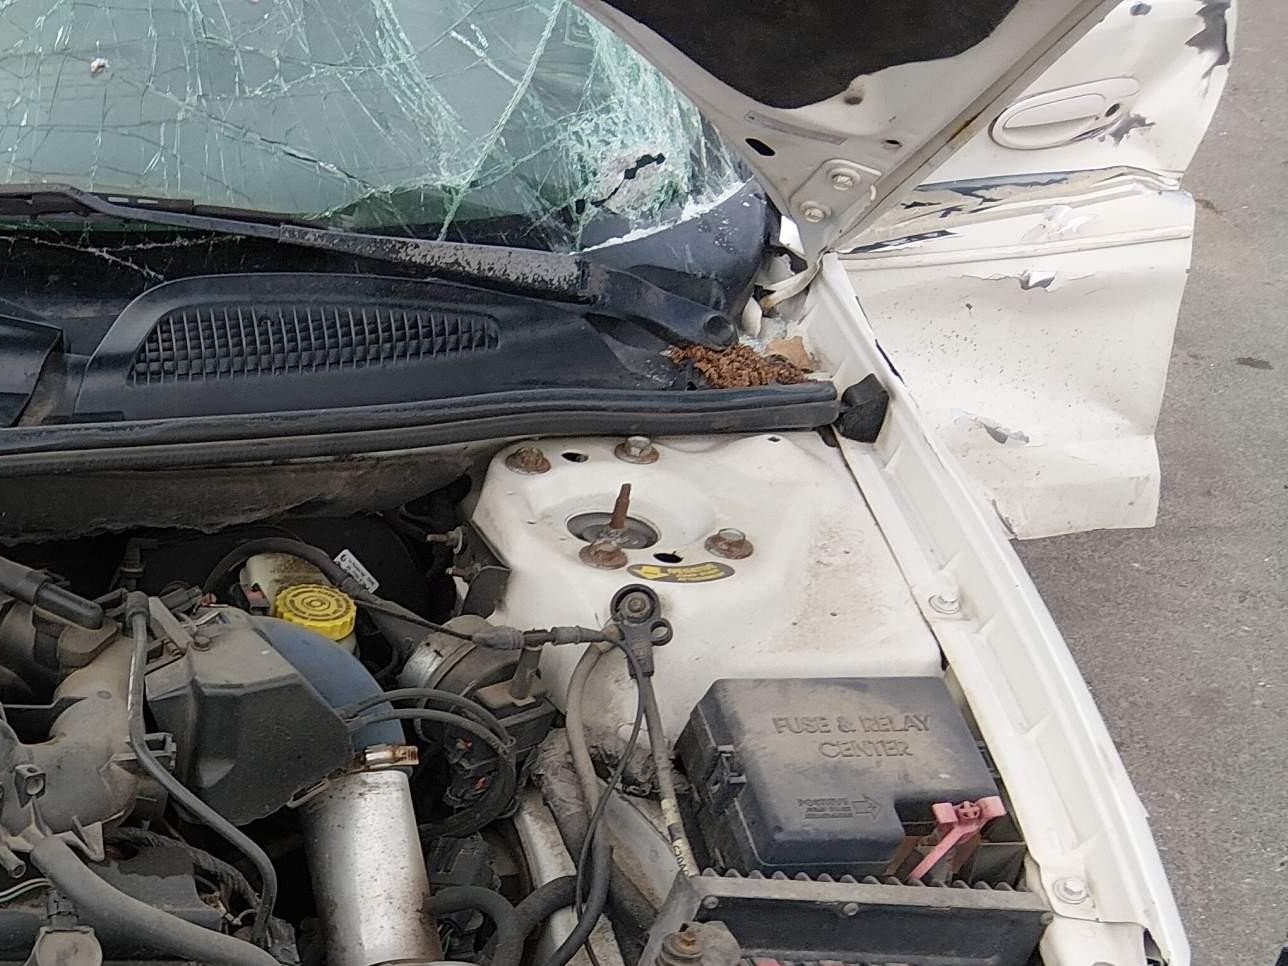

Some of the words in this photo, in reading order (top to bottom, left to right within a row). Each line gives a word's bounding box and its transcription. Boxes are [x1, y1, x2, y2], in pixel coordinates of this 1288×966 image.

[773, 715, 831, 734] FUSE
[836, 715, 857, 733] &
[858, 714, 930, 732] RELAY
[818, 740, 914, 758] CENTER
